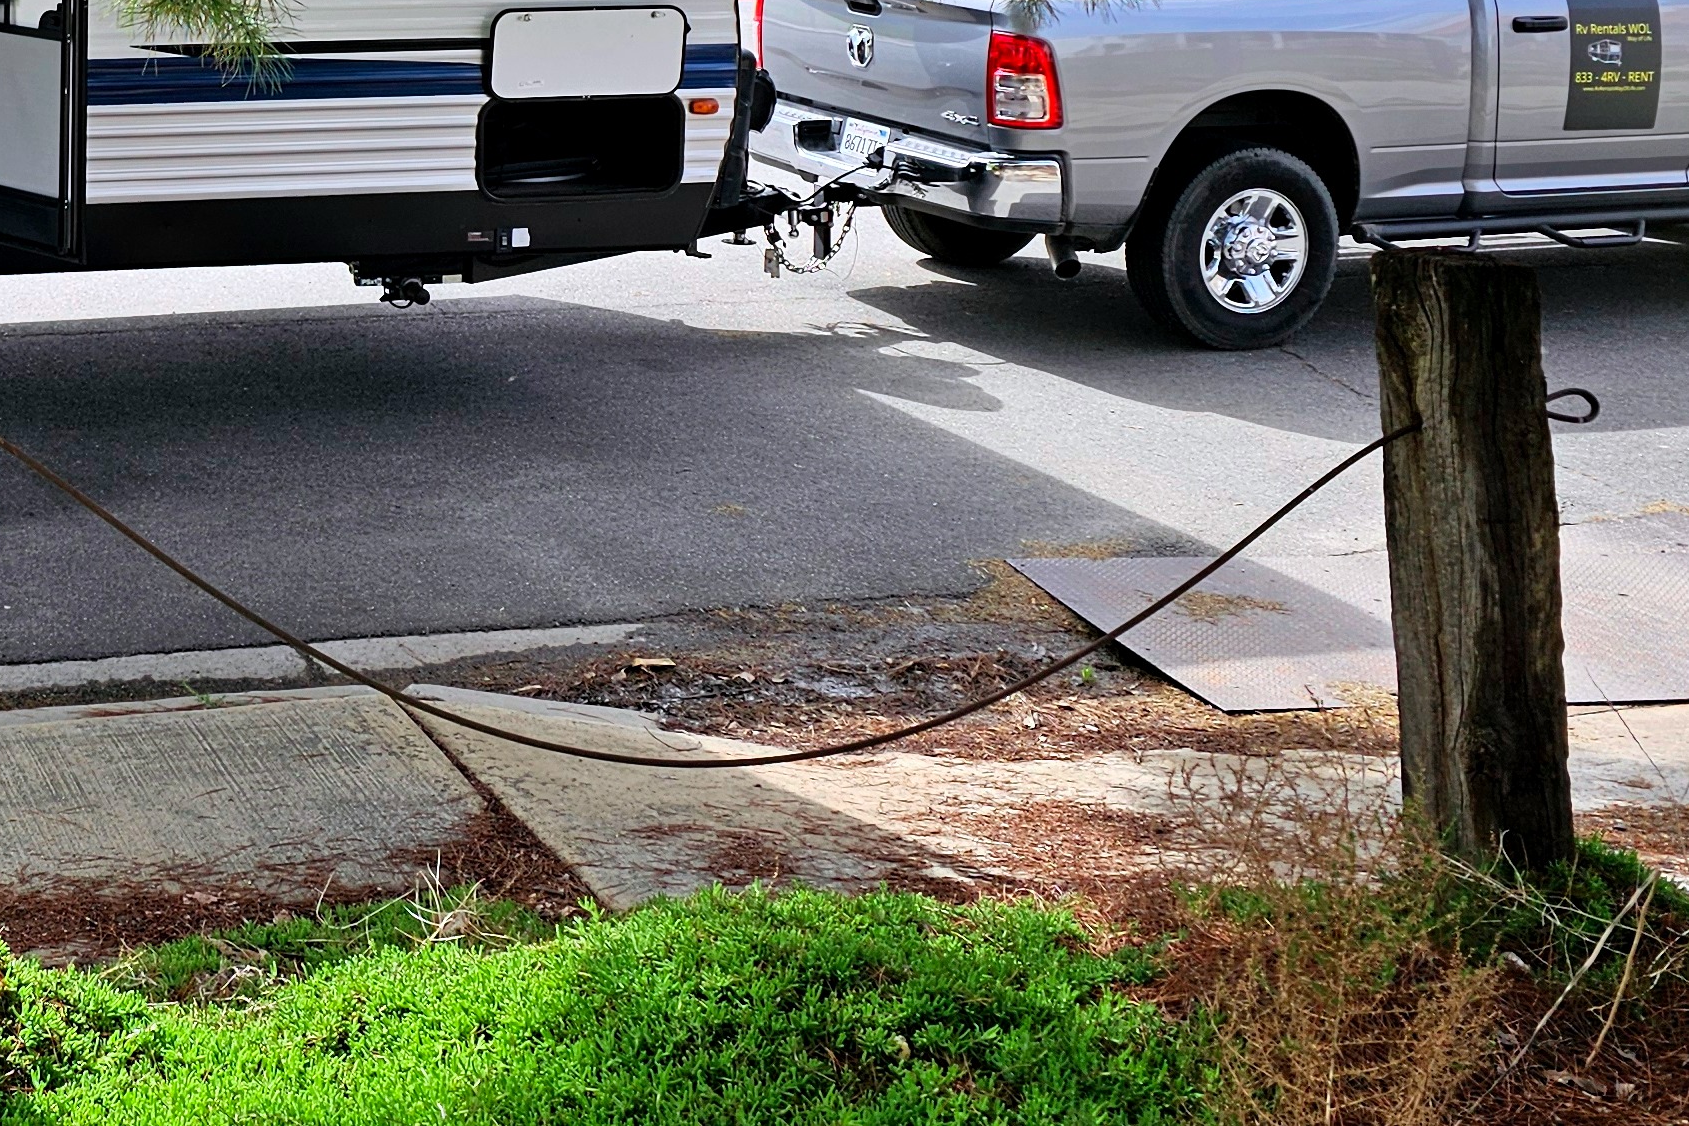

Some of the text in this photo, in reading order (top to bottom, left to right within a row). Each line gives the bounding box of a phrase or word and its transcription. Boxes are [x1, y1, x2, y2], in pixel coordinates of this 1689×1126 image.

[1575, 23, 1653, 35] Rv Rentals WOL
[1575, 72, 1593, 83] 833
[1601, 72, 1620, 83] 4RV
[1628, 71, 1655, 83] RENT
